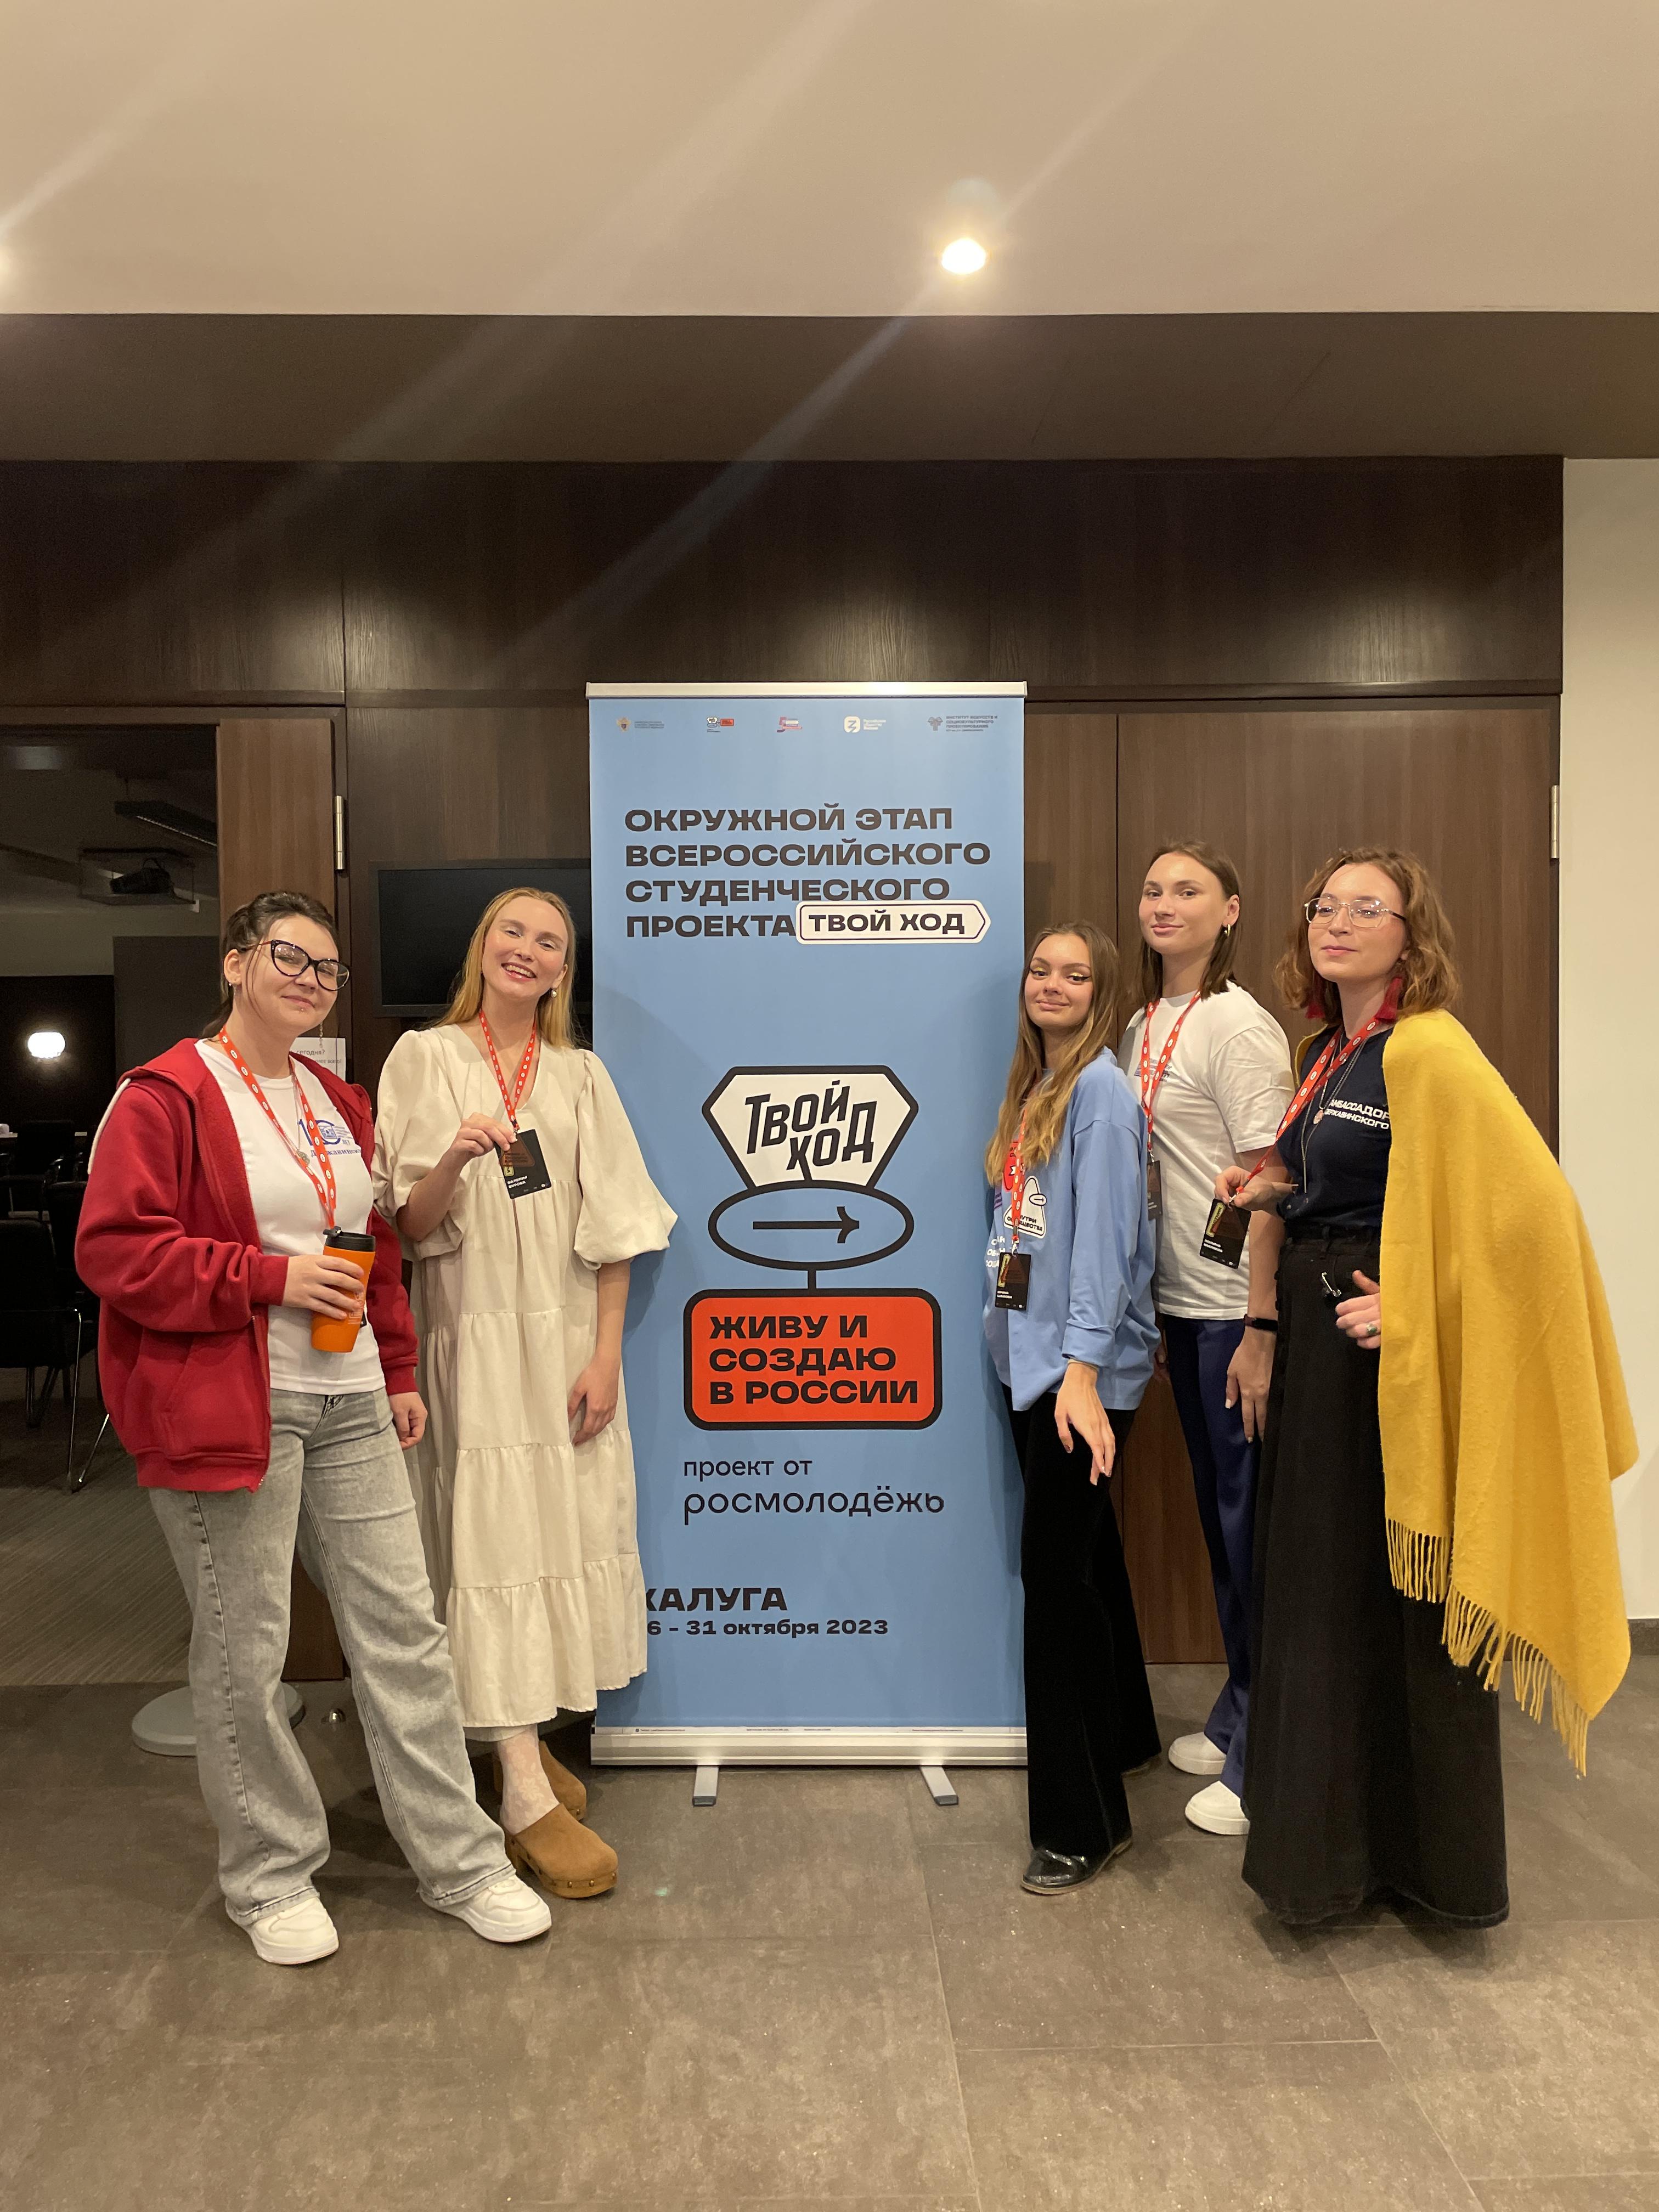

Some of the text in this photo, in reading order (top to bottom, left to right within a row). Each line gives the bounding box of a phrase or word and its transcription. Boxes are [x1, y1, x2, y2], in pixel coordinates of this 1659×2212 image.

[625, 803, 952, 832] ОКРУЖНОЙ ЭТАП
[626, 838, 990, 867] ВСЕРОССИЙСКОГО
[626, 878, 949, 906] СТУДЕНЧЕСКОГО
[627, 909, 965, 937] ПРОЕКТА ТВОЙ ХОД
[709, 1315, 867, 1339] ЖИВУ И
[709, 1348, 896, 1376] СОЗДАЮ
[711, 1380, 918, 1404] В РОССИИ
[685, 1460, 812, 1482] проект от
[685, 1486, 944, 1525] росмолодёжь
[647, 1621, 662, 1635] 6
[686, 1621, 716, 1635] 31
[724, 1619, 819, 1638] октября
[827, 1620, 888, 1634] 2023
